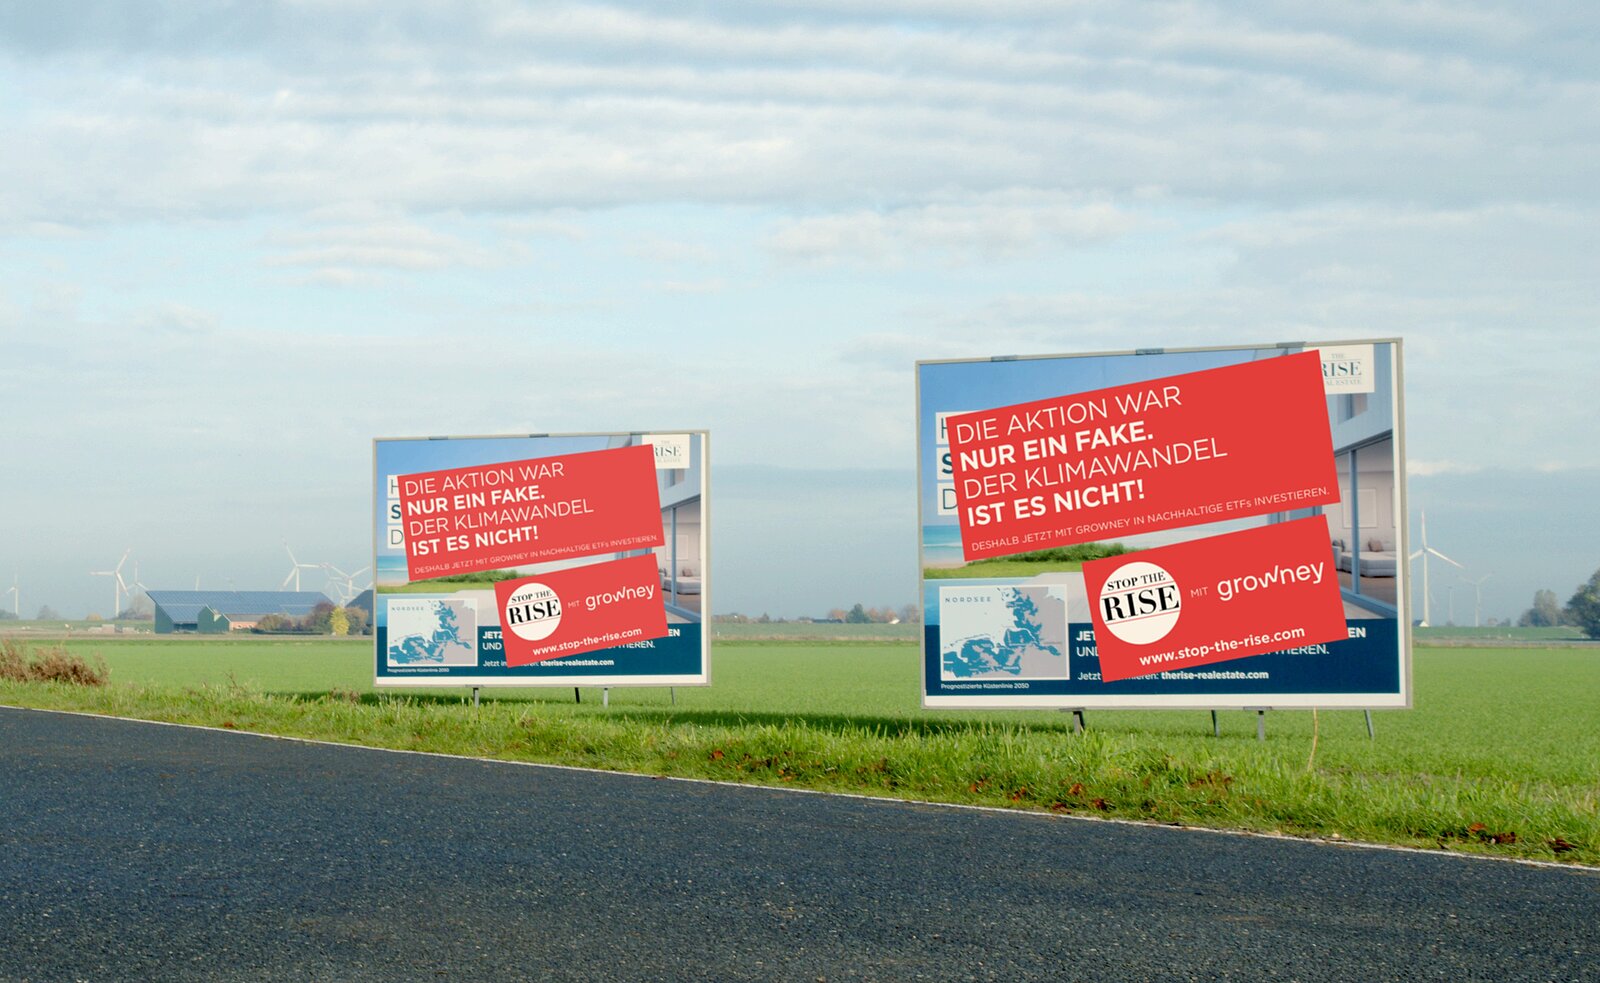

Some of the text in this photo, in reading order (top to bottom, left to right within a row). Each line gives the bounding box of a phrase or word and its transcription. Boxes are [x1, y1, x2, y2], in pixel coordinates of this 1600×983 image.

[956, 418, 999, 444] DIE
[1007, 398, 1108, 436] AKTION
[1115, 386, 1182, 415] WAR
[960, 420, 1154, 472] NUR EIN FAKE.
[405, 462, 564, 496] DIE AKTION WAR
[964, 438, 1228, 500] DER KLIMAWANDEL
[407, 485, 545, 517] NUR EIN FAKE.
[410, 498, 594, 537] DER KLIMAWANDEL
[968, 479, 1145, 527] IST ES NICHT!
[972, 486, 1330, 552] DESHALB JETZT MIT GROWNEY IN NACHHALTIGE ETFs INVESTIEREN.
[412, 526, 538, 556] IST ES NICHT!
[414, 564, 450, 574] DESHALB
[452, 560, 474, 569] JETZT
[476, 557, 488, 566] MIT
[490, 554, 528, 564] GROWNEY
[540, 543, 591, 556] NACHHALTIGE
[592, 541, 609, 550] ETFs
[511, 590, 552, 604] STOP THE
[568, 584, 655, 611] MIT growney
[1107, 571, 1166, 591] STOP THE
[1190, 562, 1325, 601] MIT growney
[508, 598, 561, 626] RISE
[1101, 584, 1180, 622] RISE
[482, 642, 502, 650] UND
[533, 627, 642, 656] www.stop-the-rise.com
[1139, 627, 1306, 666] www.stop-the-rise.com
[540, 659, 614, 667] therise-realestate.com
[1078, 672, 1101, 680] Jetzt
[1161, 670, 1269, 680] therise-realestate.com
